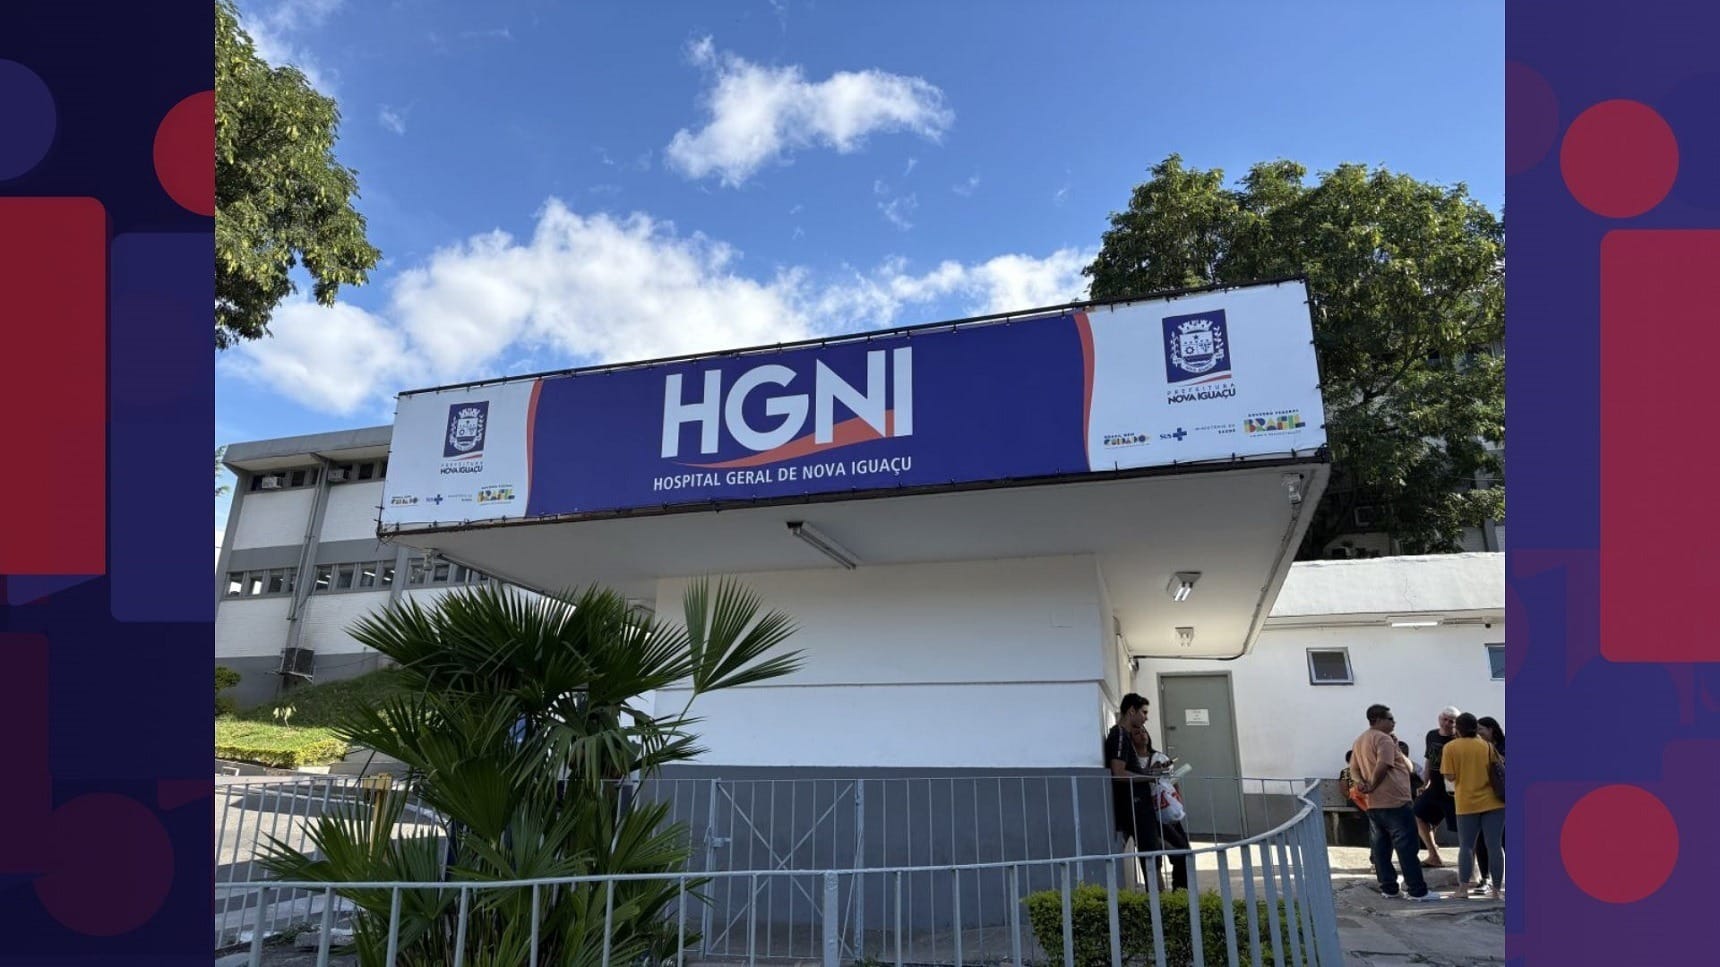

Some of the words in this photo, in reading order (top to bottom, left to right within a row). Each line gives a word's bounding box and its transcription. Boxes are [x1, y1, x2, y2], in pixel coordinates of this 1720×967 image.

[661, 346, 913, 458] HGNI
[1168, 393, 1197, 405] NOVA
[1198, 388, 1236, 401] IGUAÇU
[653, 473, 721, 491] HOSPITAL
[726, 468, 773, 485] GERAL
[778, 467, 797, 481] DE
[802, 462, 846, 479] NOVA
[851, 456, 912, 477] IGUAÇU
